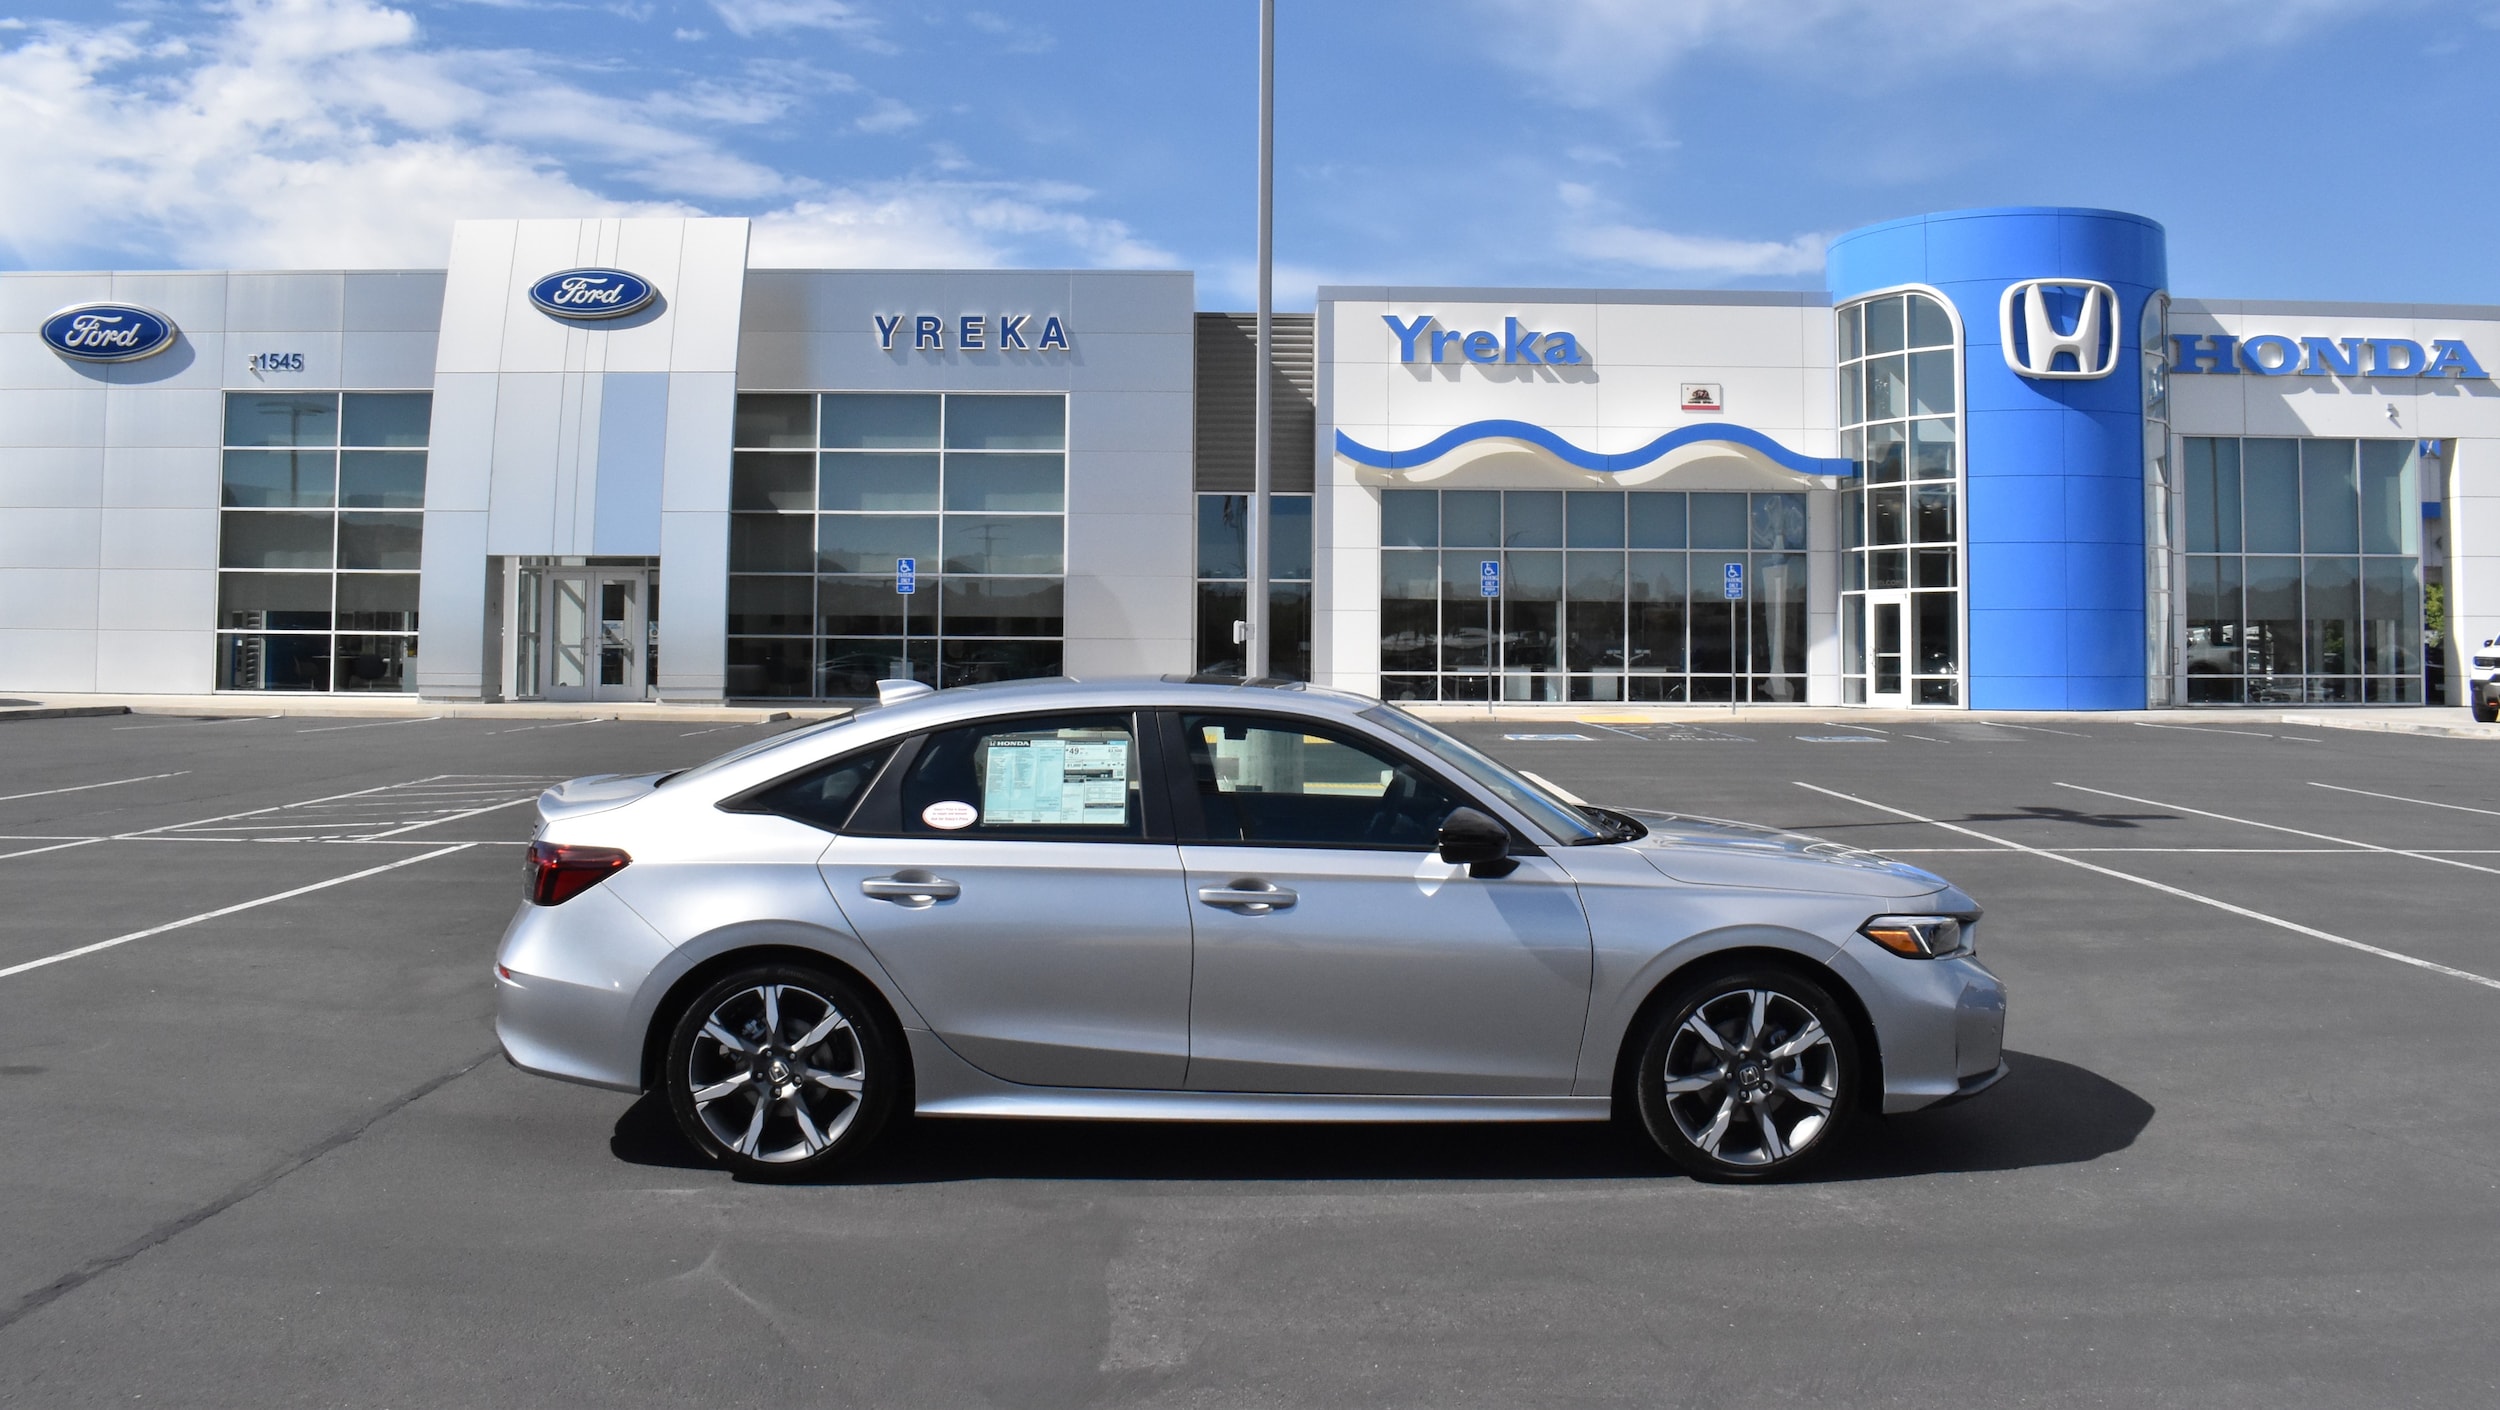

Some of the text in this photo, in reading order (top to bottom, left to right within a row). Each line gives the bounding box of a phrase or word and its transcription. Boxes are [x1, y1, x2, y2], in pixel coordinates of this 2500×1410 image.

[553, 277, 625, 304] Ford
[65, 315, 142, 347] Ford
[873, 314, 1071, 351] YREKA
[1381, 314, 1583, 365] Yreka
[259, 352, 303, 370] 1545
[2170, 333, 2491, 379] HONDA
